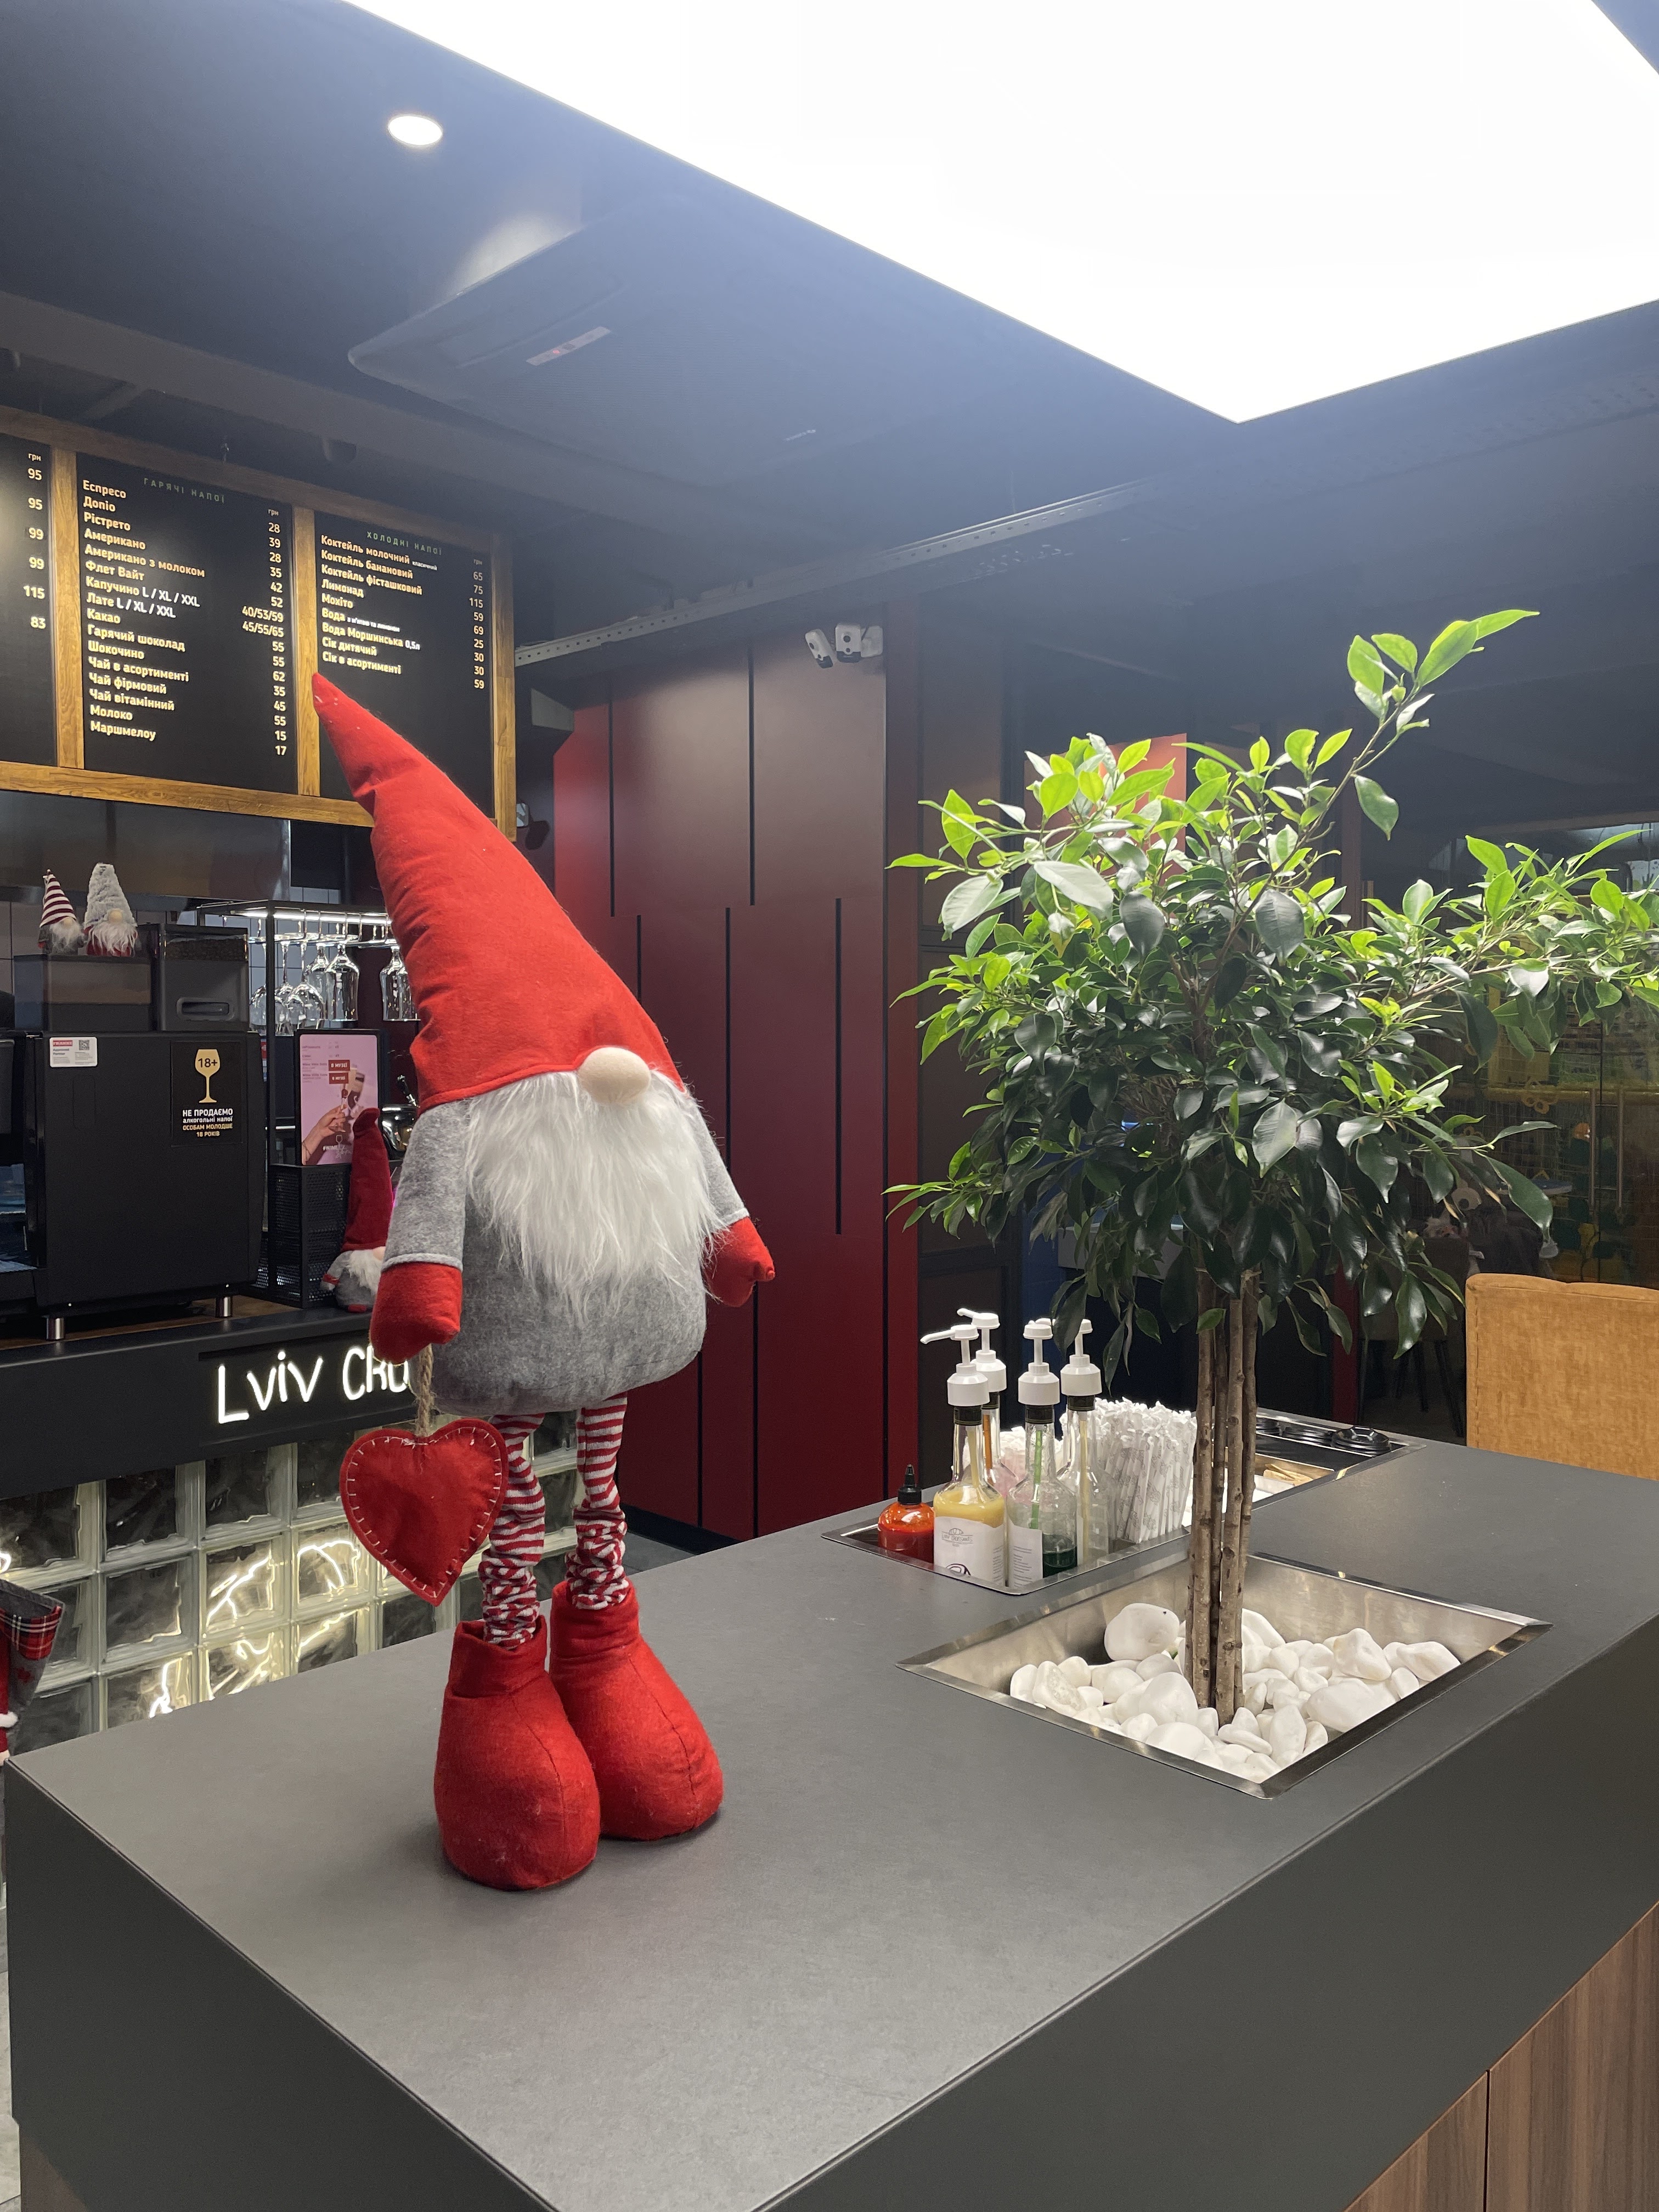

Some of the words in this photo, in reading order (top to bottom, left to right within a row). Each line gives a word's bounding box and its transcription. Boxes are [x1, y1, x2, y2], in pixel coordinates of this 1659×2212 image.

[29, 453, 41, 461] грн
[28, 468, 42, 481] 95
[83, 479, 126, 499] Еспресо
[143, 478, 184, 494] ГАРЯЧІ
[191, 489, 224, 504] НАПОЇ
[29, 498, 42, 510] 95
[83, 495, 116, 512] Допіо
[83, 511, 131, 531] Рістрето
[269, 522, 280, 533] 28
[29, 527, 44, 540] 99
[84, 528, 146, 550] Американо
[269, 537, 281, 548] 39
[367, 531, 409, 548] ХОЛОДНІ
[414, 543, 442, 555] НАПОЇ
[321, 535, 363, 554] Коктейль
[366, 547, 410, 564] молочний
[29, 557, 44, 569] 99
[84, 544, 146, 566] Американо
[149, 559, 155, 567] з
[159, 561, 205, 578] молоком
[269, 552, 281, 563] 28
[85, 560, 115, 576] Флет
[118, 566, 144, 581] Вайт
[321, 550, 364, 568] Коктейль
[366, 561, 413, 579] банановий
[270, 567, 282, 578] 35
[473, 572, 483, 581] 65
[321, 565, 364, 582] Коктейль
[366, 574, 422, 595] фісташковий
[24, 585, 45, 599] 115
[86, 576, 139, 597] Капучино
[142, 586, 149, 599] L
[159, 590, 172, 602] XL
[181, 594, 200, 607] XXL
[270, 582, 283, 593] 42
[321, 578, 364, 598] Лимонад
[473, 585, 483, 594] 75
[86, 591, 114, 608] Лате
[116, 596, 123, 609] L
[133, 600, 147, 613] XL
[157, 604, 176, 618] XXL
[271, 596, 283, 608] 52
[321, 593, 353, 609] Мохіто
[469, 598, 483, 608] 115
[87, 608, 121, 624] Какао
[242, 606, 284, 623] 40/53/59
[322, 607, 345, 622] Вода
[473, 612, 483, 622] 59
[30, 616, 46, 629] 83
[242, 621, 284, 637] 45/55/65
[322, 622, 346, 636] Вода
[347, 627, 403, 647] Моршинська
[405, 640, 420, 650] 0,5л
[473, 626, 483, 635] 69
[87, 624, 134, 642] Гарячий
[137, 632, 185, 652] шоколад
[473, 639, 483, 648] 25
[88, 640, 144, 659] Шокочино
[272, 641, 284, 652] 55
[322, 636, 336, 648] Сік
[338, 640, 377, 656] дитячий
[273, 656, 285, 667] 55
[323, 651, 336, 663] Сік
[347, 657, 401, 675] асортименті
[474, 652, 484, 662] 30
[88, 657, 110, 670] Чай
[113, 663, 120, 672] в
[123, 664, 189, 682] асортименті
[474, 665, 484, 675] 30
[89, 672, 111, 686] Чай
[114, 675, 167, 694] фірмовий
[273, 671, 285, 682] 62
[474, 679, 484, 689] 59
[273, 686, 285, 697] 35
[89, 688, 111, 702] Чай
[115, 692, 174, 711] вітамінний
[90, 704, 133, 720] Молоко
[274, 701, 286, 712] 45
[274, 715, 286, 726] 55
[90, 720, 156, 741] Маршмелоу
[275, 731, 286, 741] 15
[275, 746, 286, 756] 17
[198, 1058, 217, 1068] 18+
